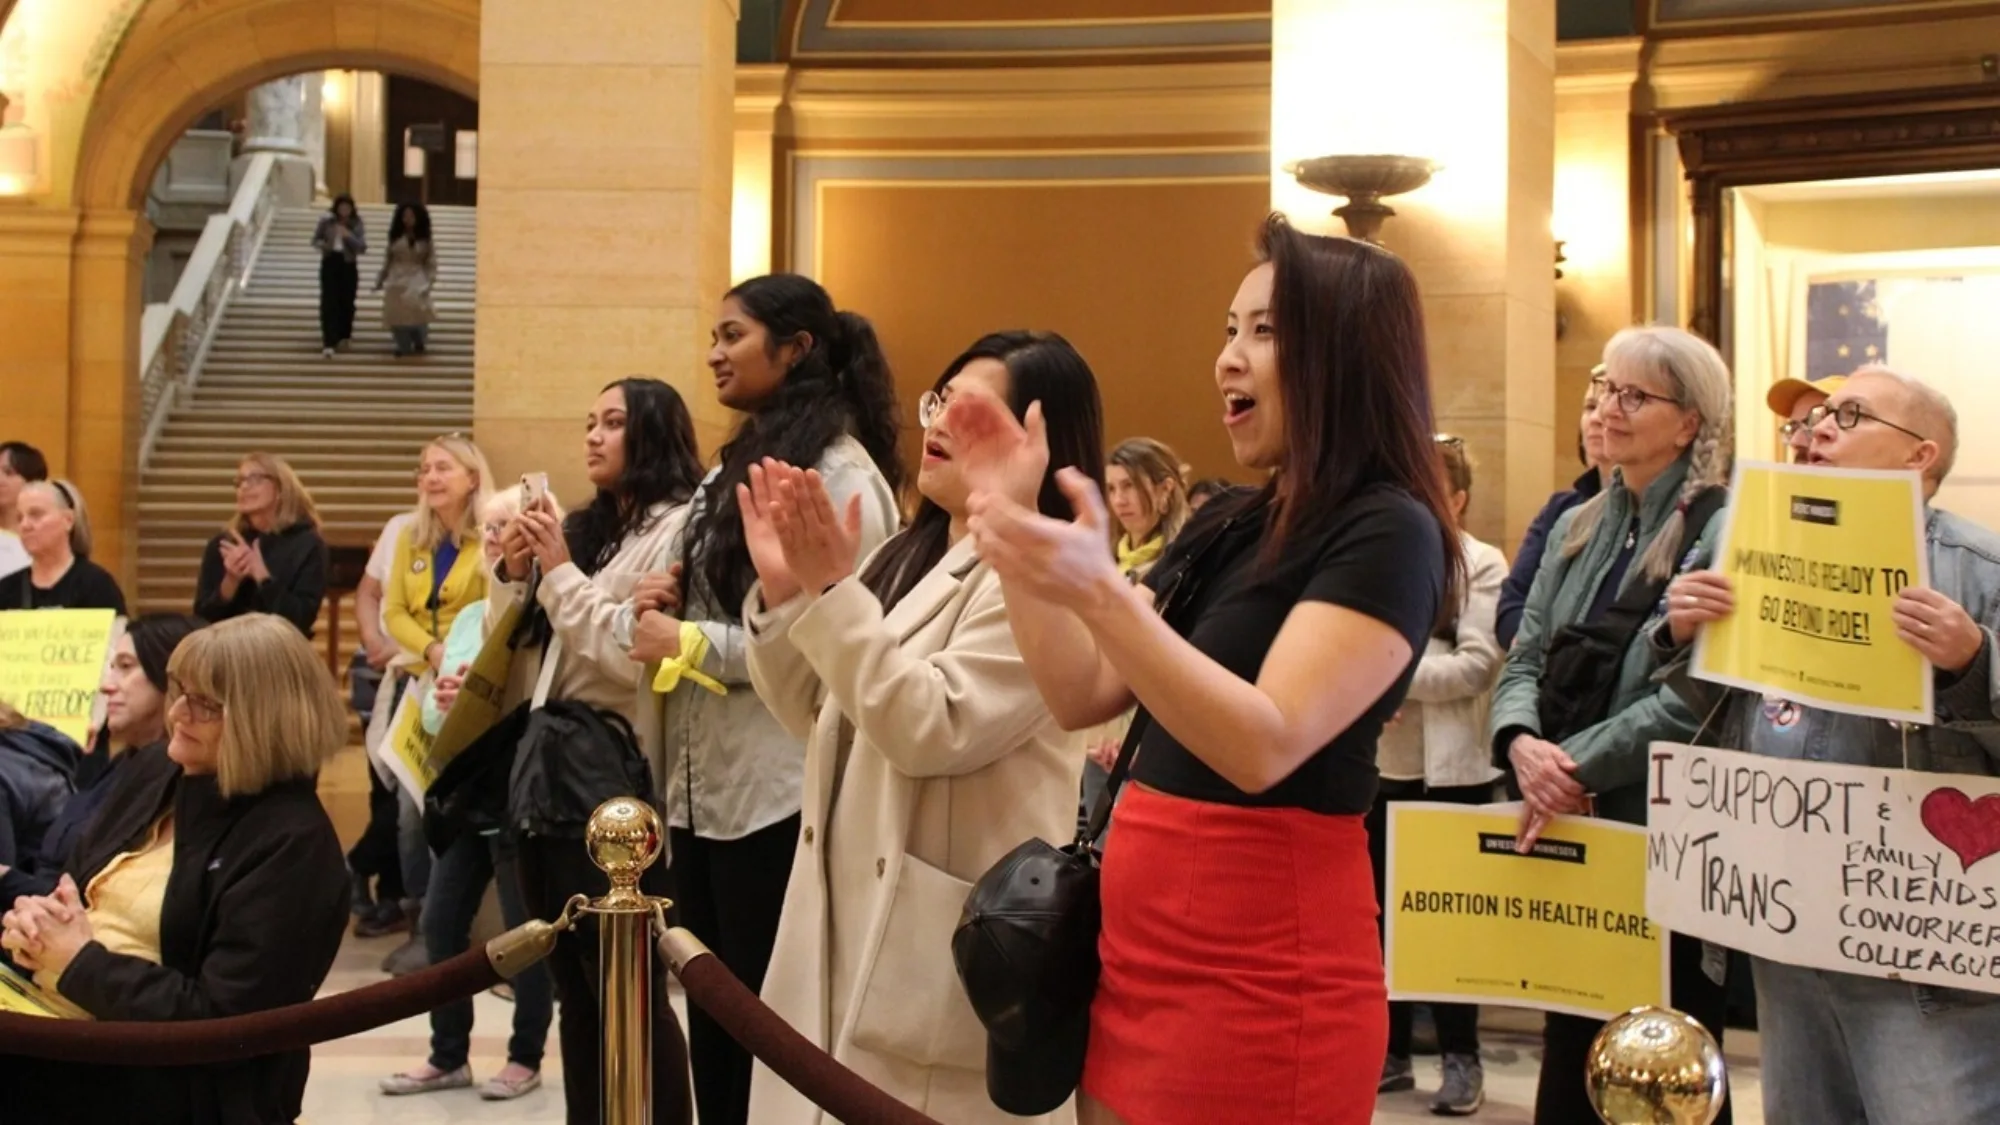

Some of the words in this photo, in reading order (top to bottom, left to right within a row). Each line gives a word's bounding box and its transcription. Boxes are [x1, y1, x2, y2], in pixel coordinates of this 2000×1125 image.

[1822, 562, 1875, 596] READY
[1881, 568, 1909, 597] TO
[1760, 595, 1780, 623] GO
[1827, 608, 1870, 641] ROE!
[1650, 753, 1673, 805] I
[1686, 757, 1865, 835] SUPPORT
[1648, 831, 1688, 881] MY
[1691, 831, 1797, 934] TRANS
[1846, 840, 1942, 878] FAMILY
[1841, 863, 1998, 910] FRIENDS
[1401, 890, 1498, 917] ABORTION
[1505, 897, 1523, 919] IS
[1529, 898, 1598, 929] HEALTH
[1603, 910, 1656, 941] CARE.
